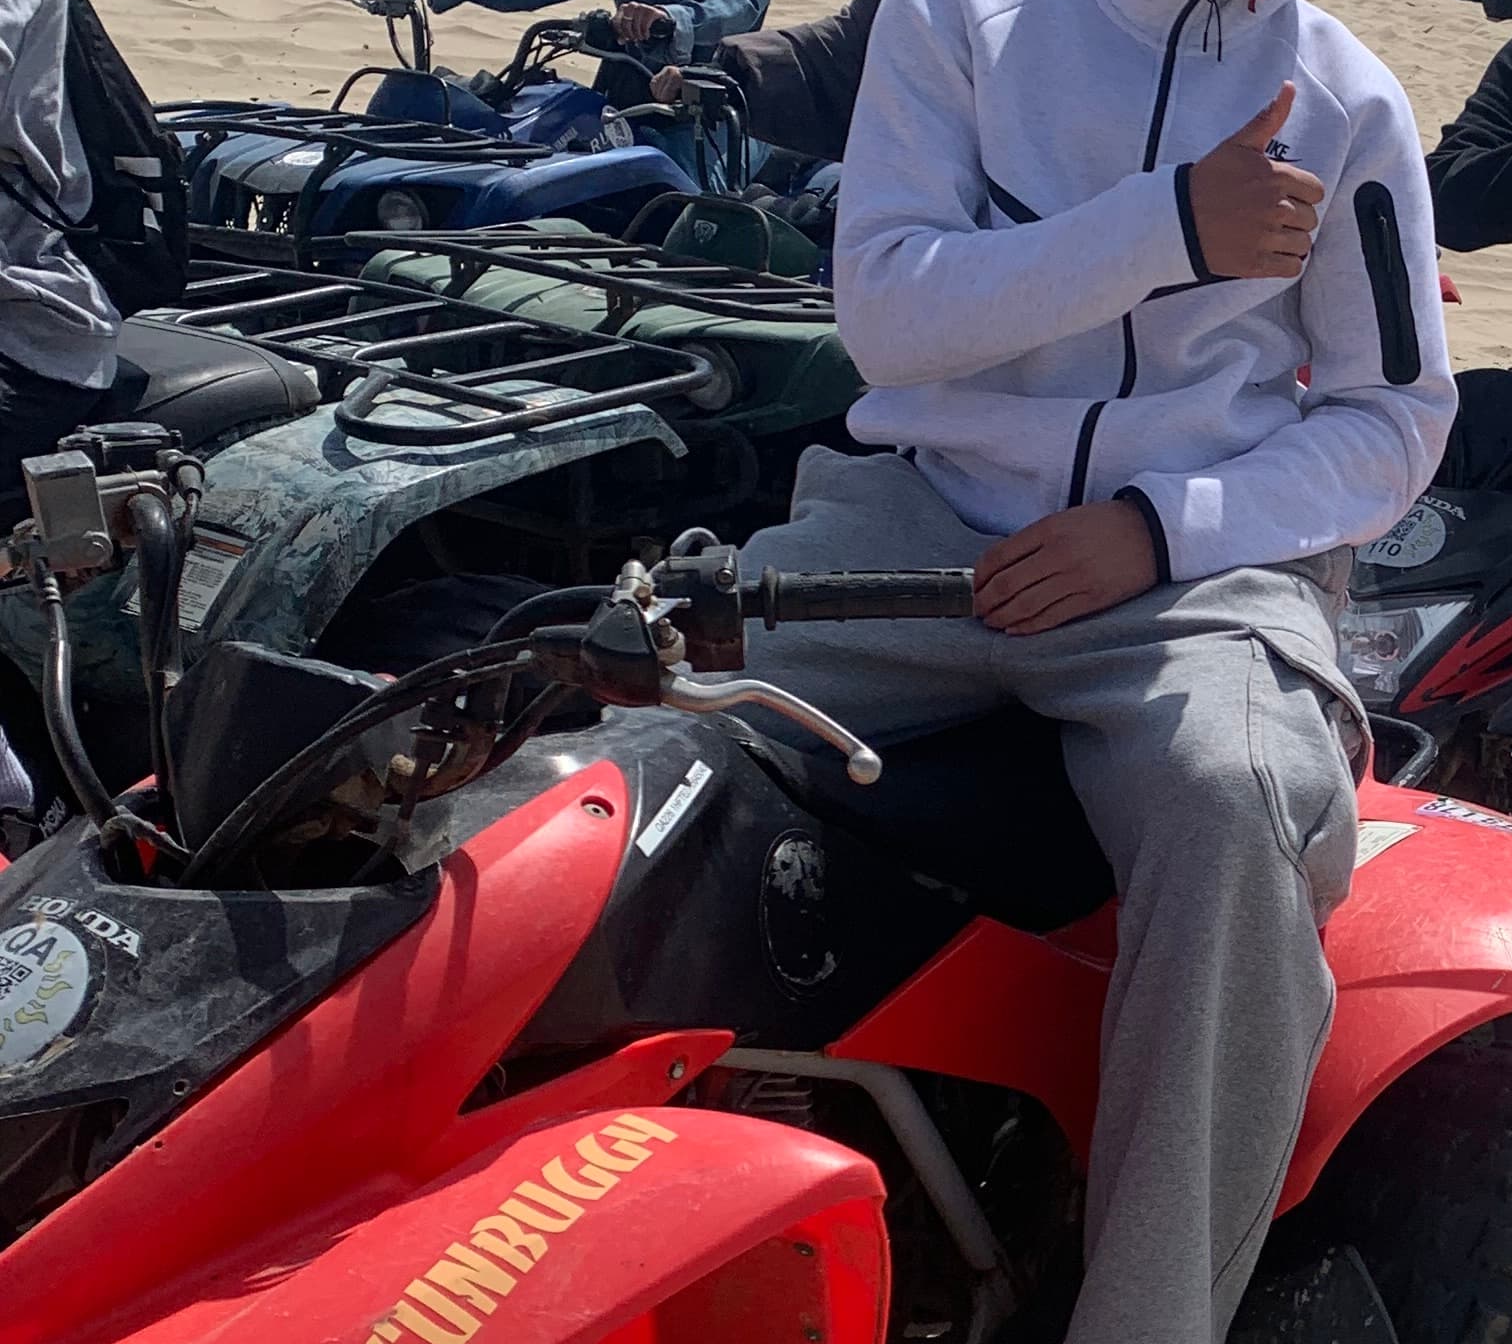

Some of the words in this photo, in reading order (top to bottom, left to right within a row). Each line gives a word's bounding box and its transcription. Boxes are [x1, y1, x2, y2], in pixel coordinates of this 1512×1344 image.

[1265, 138, 1290, 158] IKE
[1368, 539, 1402, 557] 110
[5, 927, 58, 967] QA
